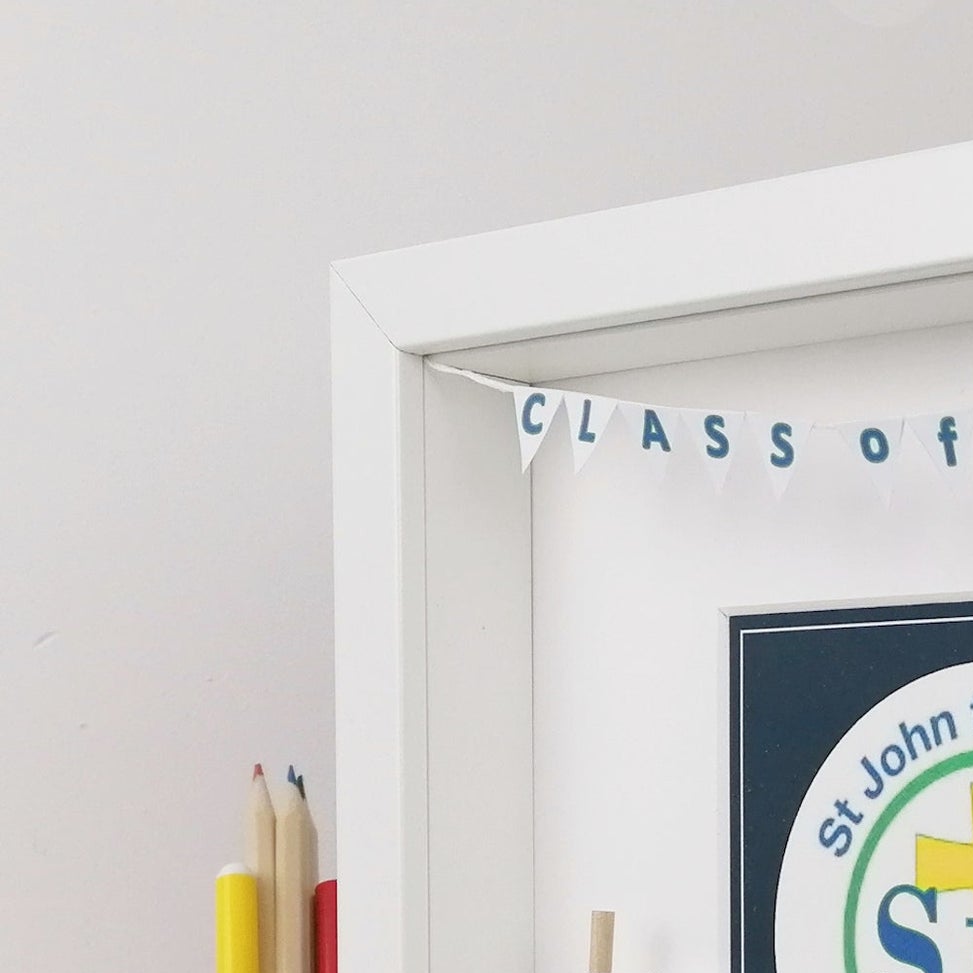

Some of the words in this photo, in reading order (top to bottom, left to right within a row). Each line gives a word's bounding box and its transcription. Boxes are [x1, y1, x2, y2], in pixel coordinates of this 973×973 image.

[520, 392, 795, 469] CLASS
[859, 416, 958, 467] of
[817, 799, 864, 858] St
[863, 706, 958, 800] John
